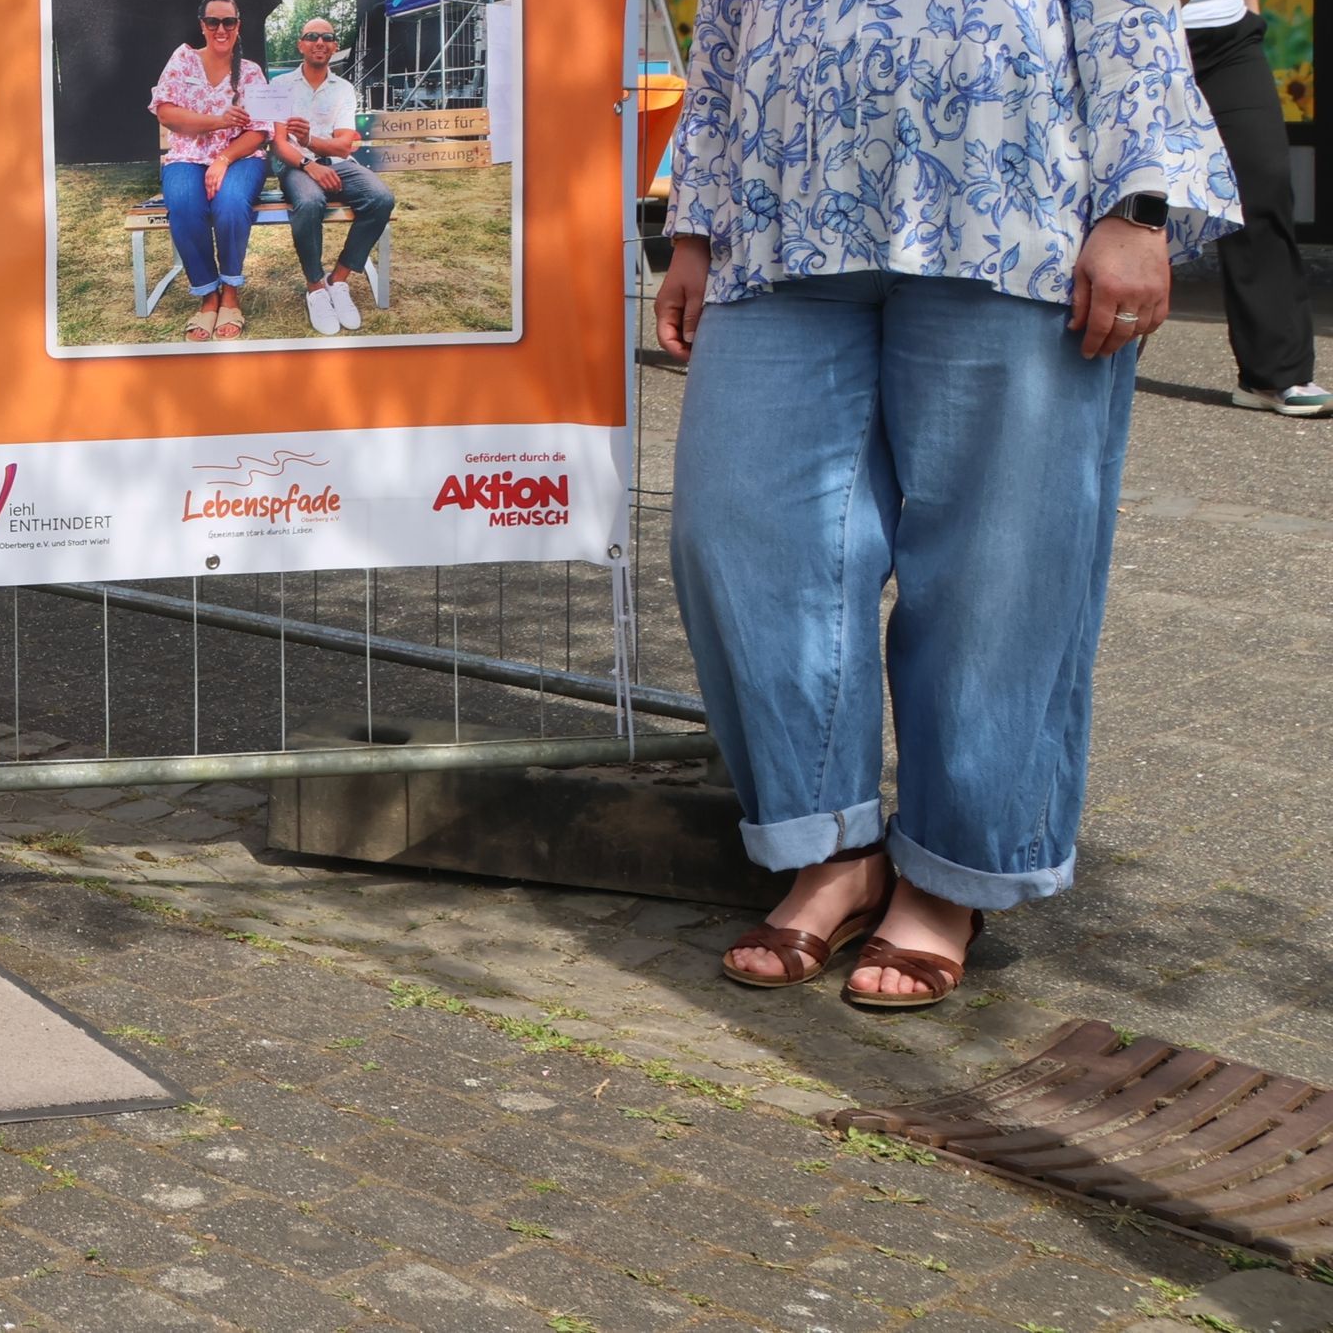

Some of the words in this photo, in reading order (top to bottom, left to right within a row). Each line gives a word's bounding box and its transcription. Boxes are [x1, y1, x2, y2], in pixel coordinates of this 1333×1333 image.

[465, 452, 516, 463] Gefördert
[519, 452, 550, 462] durch
[552, 452, 566, 462] die
[182, 483, 341, 524] Lebenspfade
[9, 516, 113, 533] ENTHINDERT
[489, 510, 569, 527] MENSCH
[51, 539, 66, 547] und
